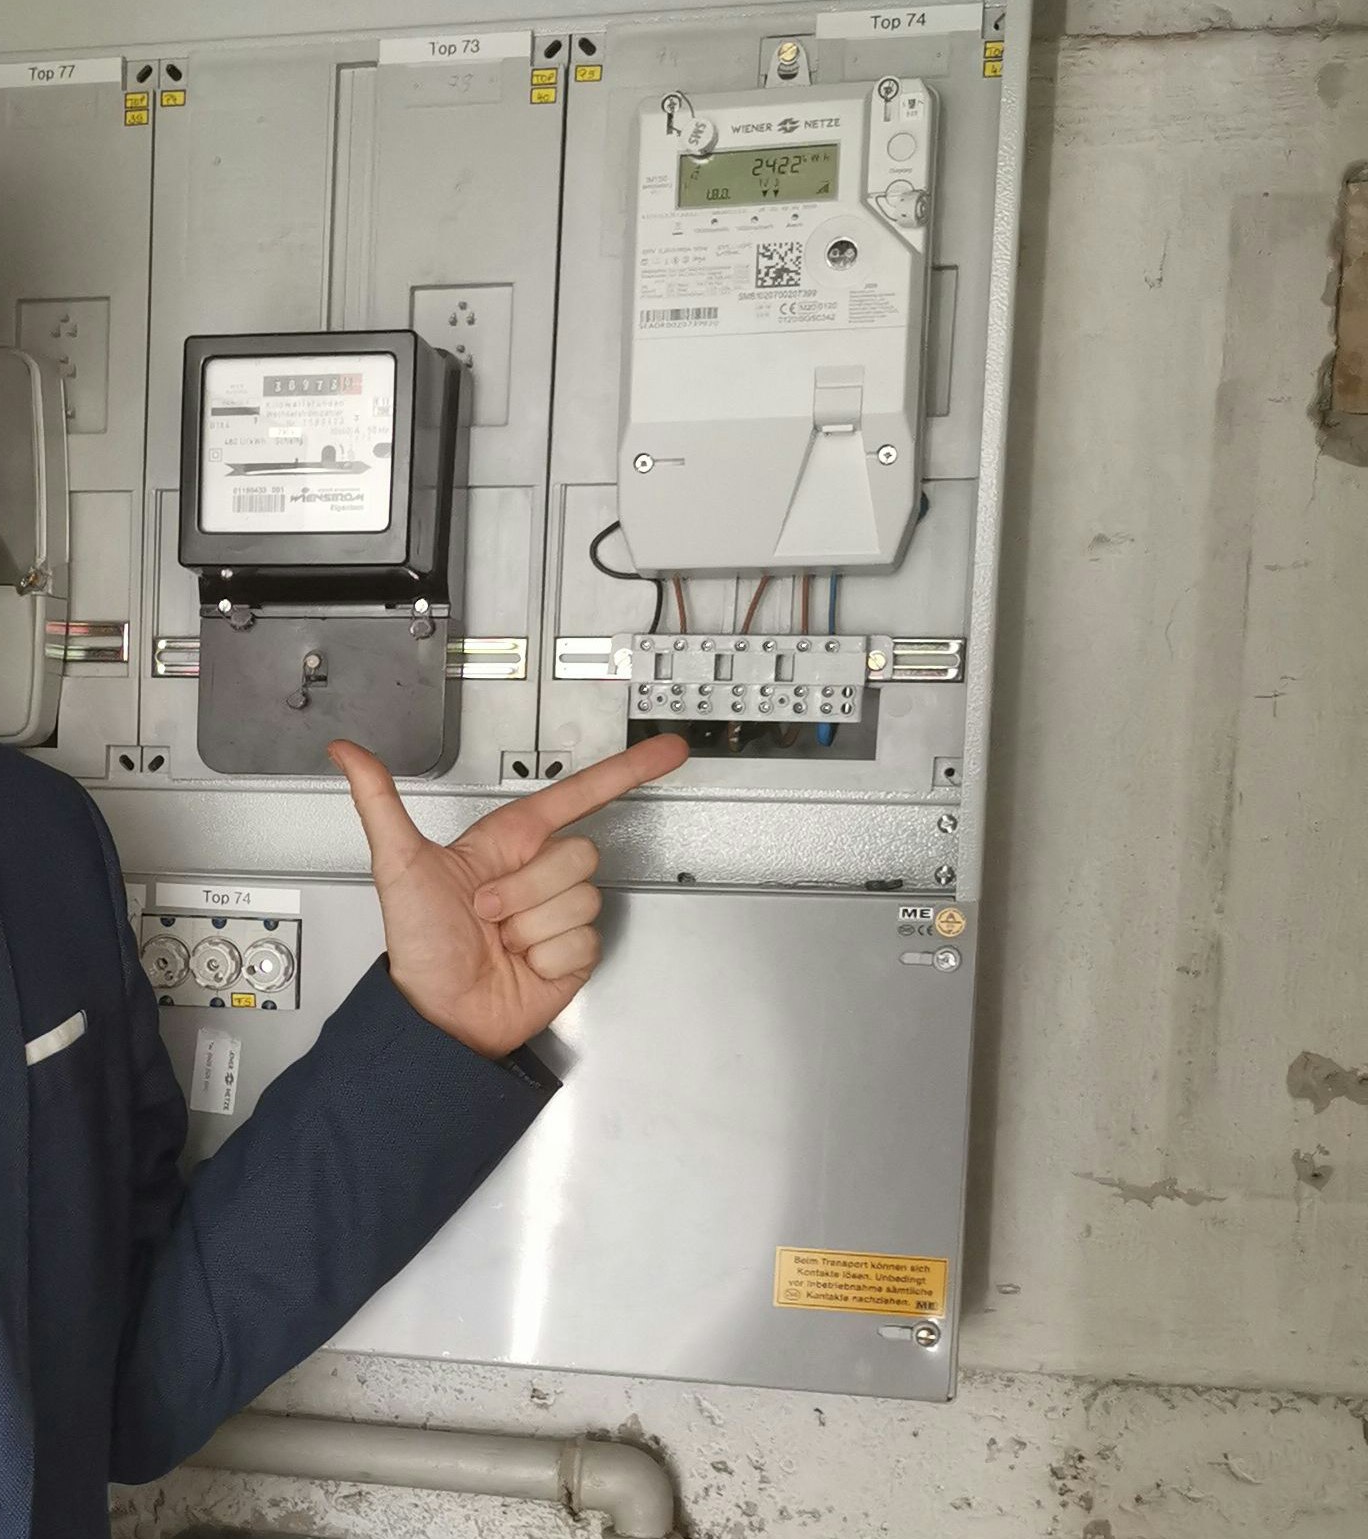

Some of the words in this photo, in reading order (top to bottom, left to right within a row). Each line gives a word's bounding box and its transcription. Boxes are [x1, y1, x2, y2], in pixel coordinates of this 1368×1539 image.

[870, 15, 901, 31] Top
[906, 13, 927, 27] 74
[429, 41, 457, 56] Top
[462, 39, 480, 53] 73
[28, 67, 55, 81] Top
[59, 65, 75, 79] 77
[688, 121, 707, 146] SMS
[732, 123, 773, 134] WIENER
[804, 118, 841, 129] NETZE
[752, 155, 802, 176] 2422
[202, 890, 230, 905] Top
[234, 891, 251, 905] 74
[902, 908, 932, 919] ME
[794, 1256, 819, 1265] Beim
[822, 1258, 868, 1270] Transport
[871, 1261, 907, 1272] können
[910, 1265, 931, 1273] sich
[797, 1269, 840, 1279] Kontakte
[875, 1273, 927, 1285] Unbedingt
[789, 1279, 804, 1287] vor
[886, 1286, 934, 1297] sämtliche
[806, 1291, 849, 1302] Kontakte
[852, 1294, 910, 1306] nachziehen.
[916, 1300, 937, 1310] ME
